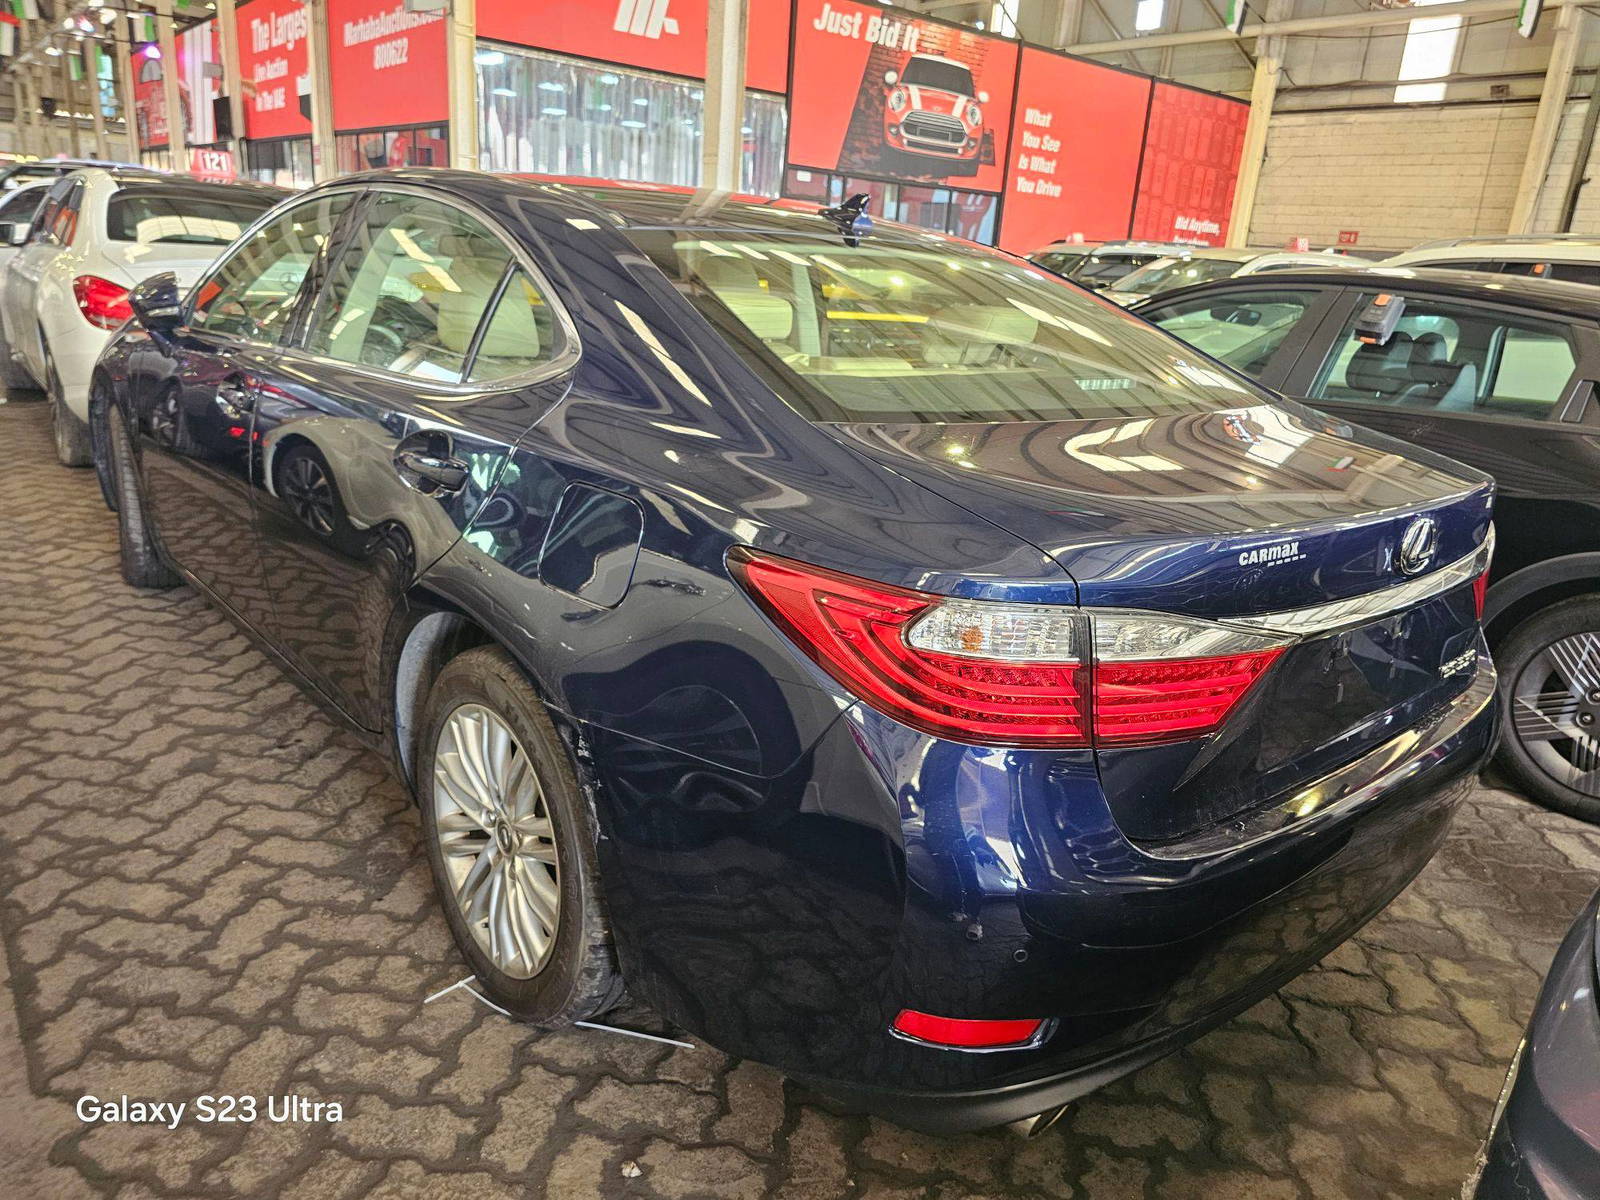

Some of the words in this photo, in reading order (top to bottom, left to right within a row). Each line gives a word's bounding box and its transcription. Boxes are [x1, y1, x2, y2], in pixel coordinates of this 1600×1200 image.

[251, 17, 270, 54] The
[270, 8, 307, 51] Larges
[813, 3, 863, 39] Just
[865, 15, 901, 48] Bid
[902, 24, 920, 53] It
[265, 56, 289, 80] Auction
[262, 90, 273, 111] The
[1024, 108, 1053, 128] What
[1022, 131, 1041, 149] You
[1041, 135, 1061, 152] See
[202, 151, 228, 171] 121
[1018, 153, 1029, 170] Is
[1029, 156, 1056, 174] What
[1016, 176, 1036, 193] You
[1035, 178, 1062, 197] Drive
[1174, 216, 1190, 230] Bid
